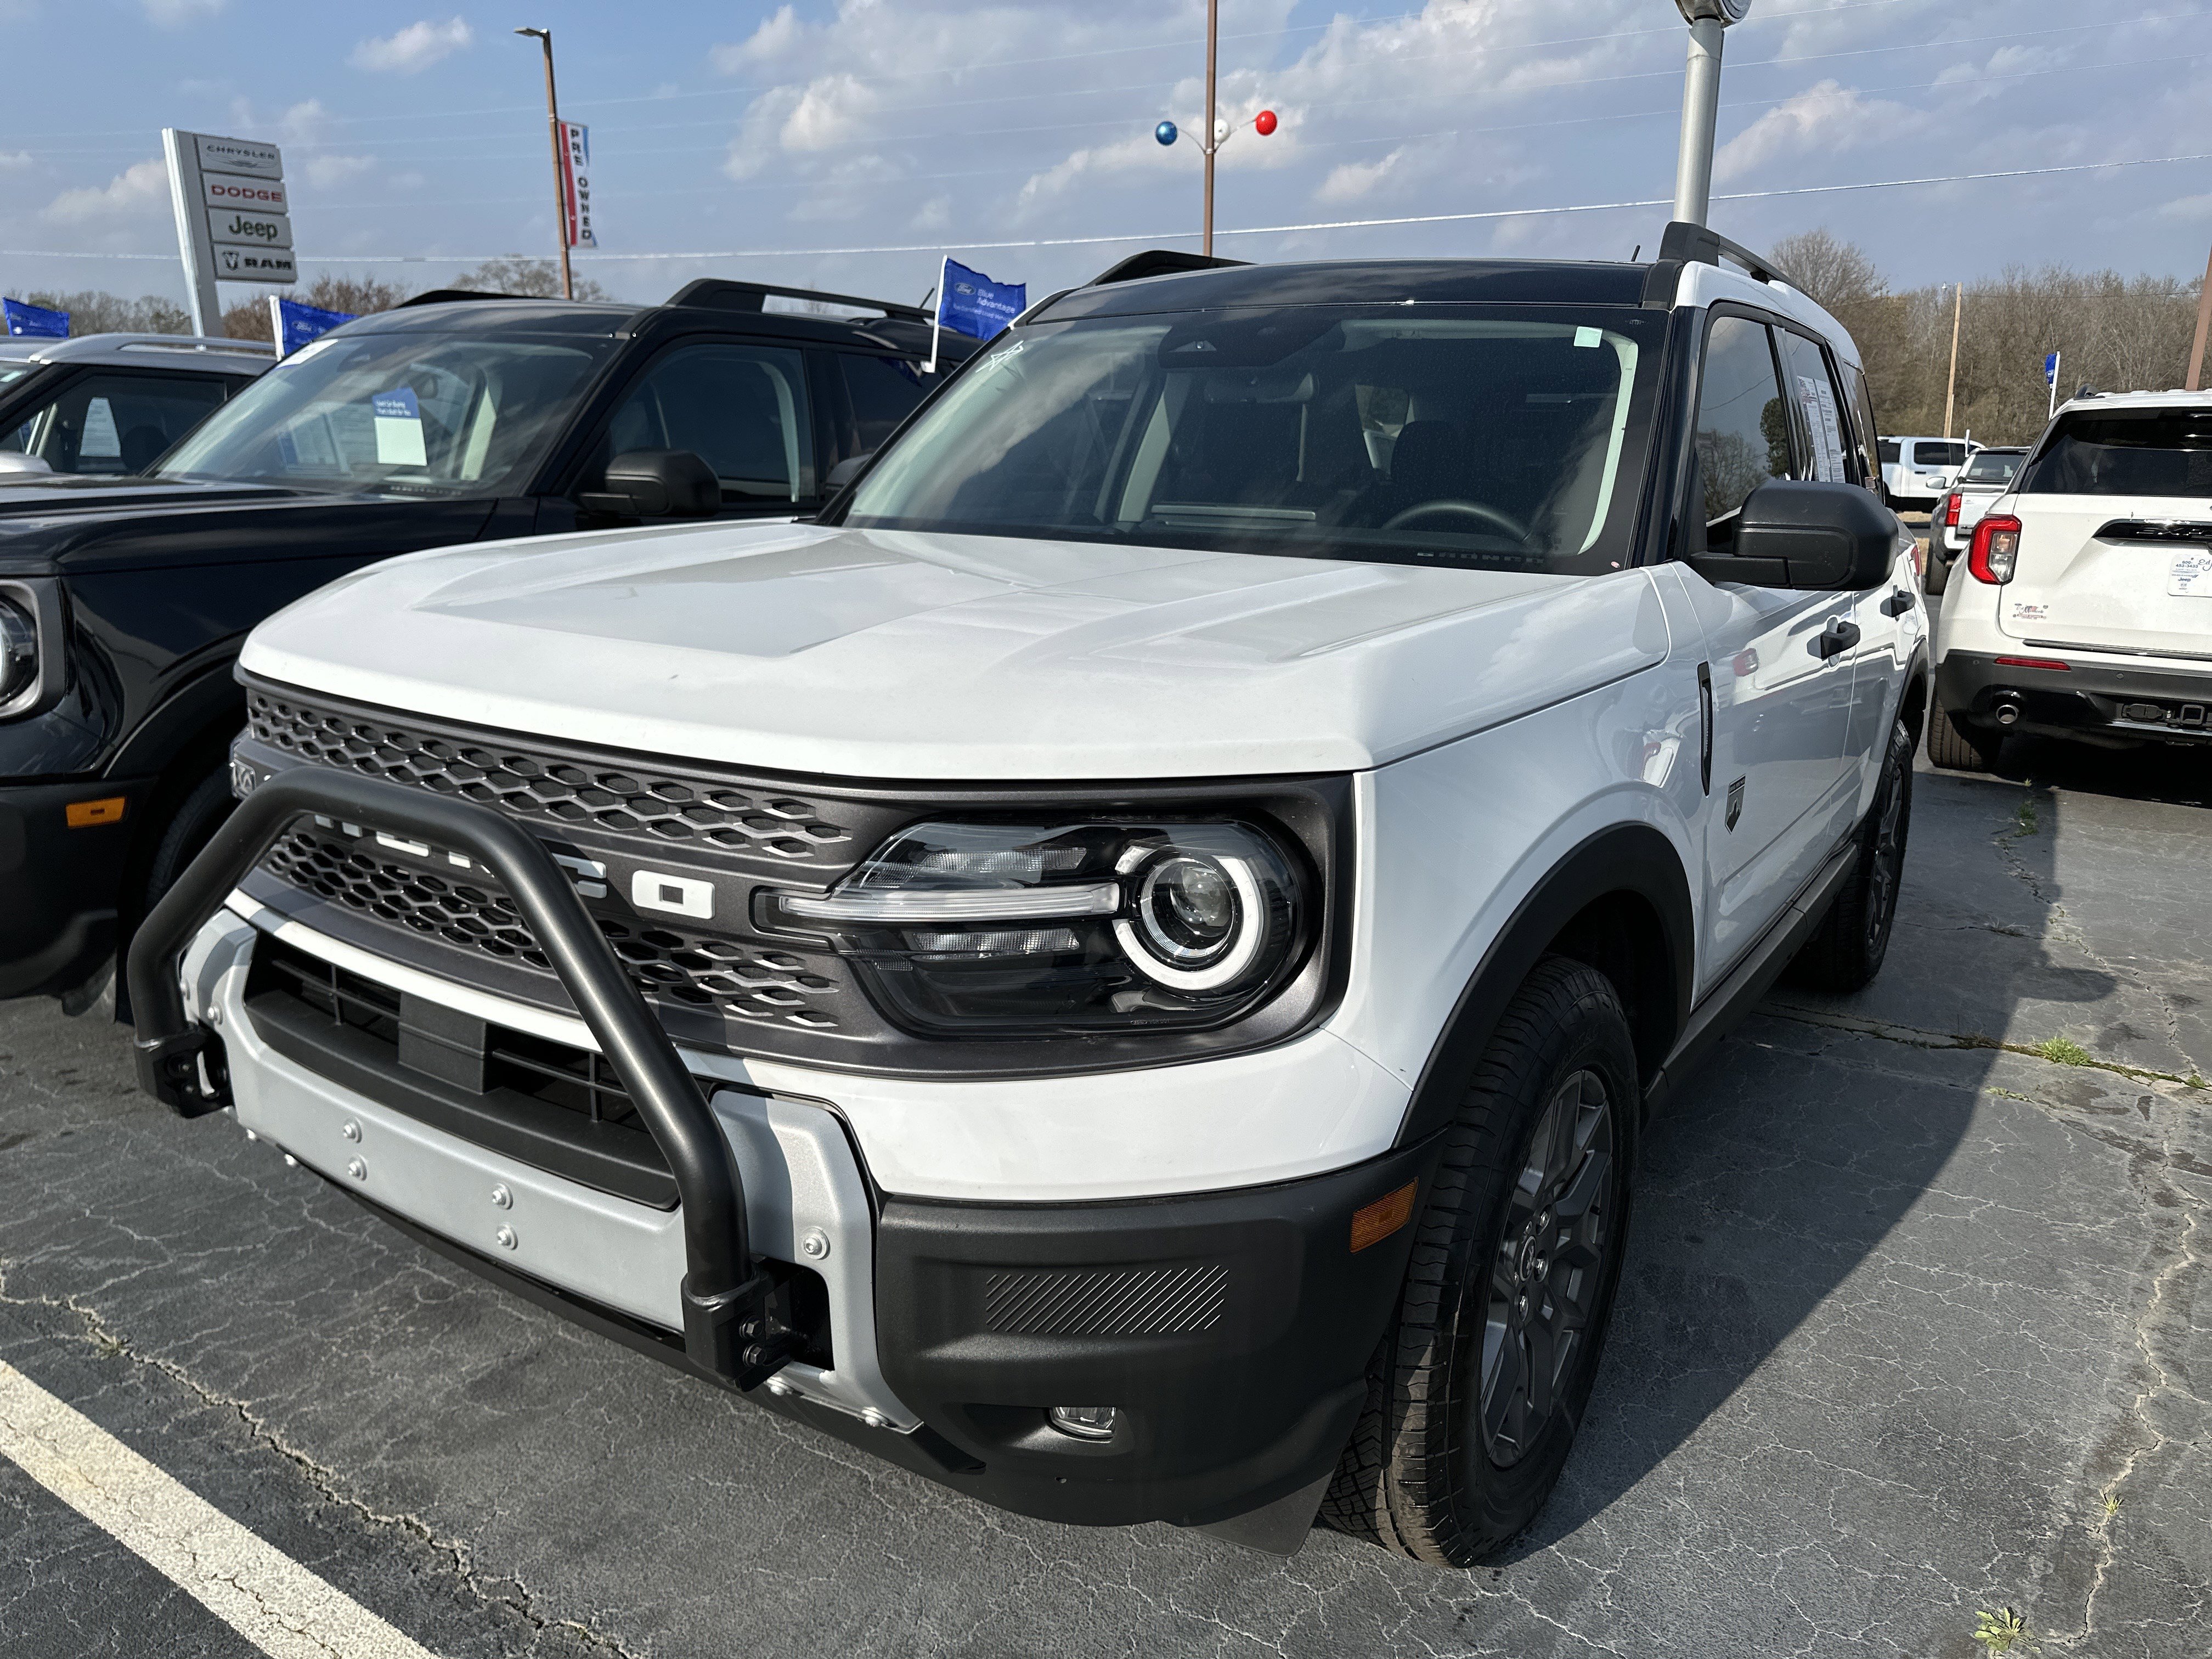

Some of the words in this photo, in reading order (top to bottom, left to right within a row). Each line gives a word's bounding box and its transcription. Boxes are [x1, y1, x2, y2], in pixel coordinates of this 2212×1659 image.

[207, 144, 275, 159] CHRYSLER
[571, 128, 583, 166] PRE
[578, 175, 592, 240] OWNED
[211, 184, 283, 202] DODGE
[228, 215, 278, 241] Jeep
[244, 257, 292, 270] RAM
[977, 289, 994, 299] Blue
[977, 297, 1015, 314] Advantage
